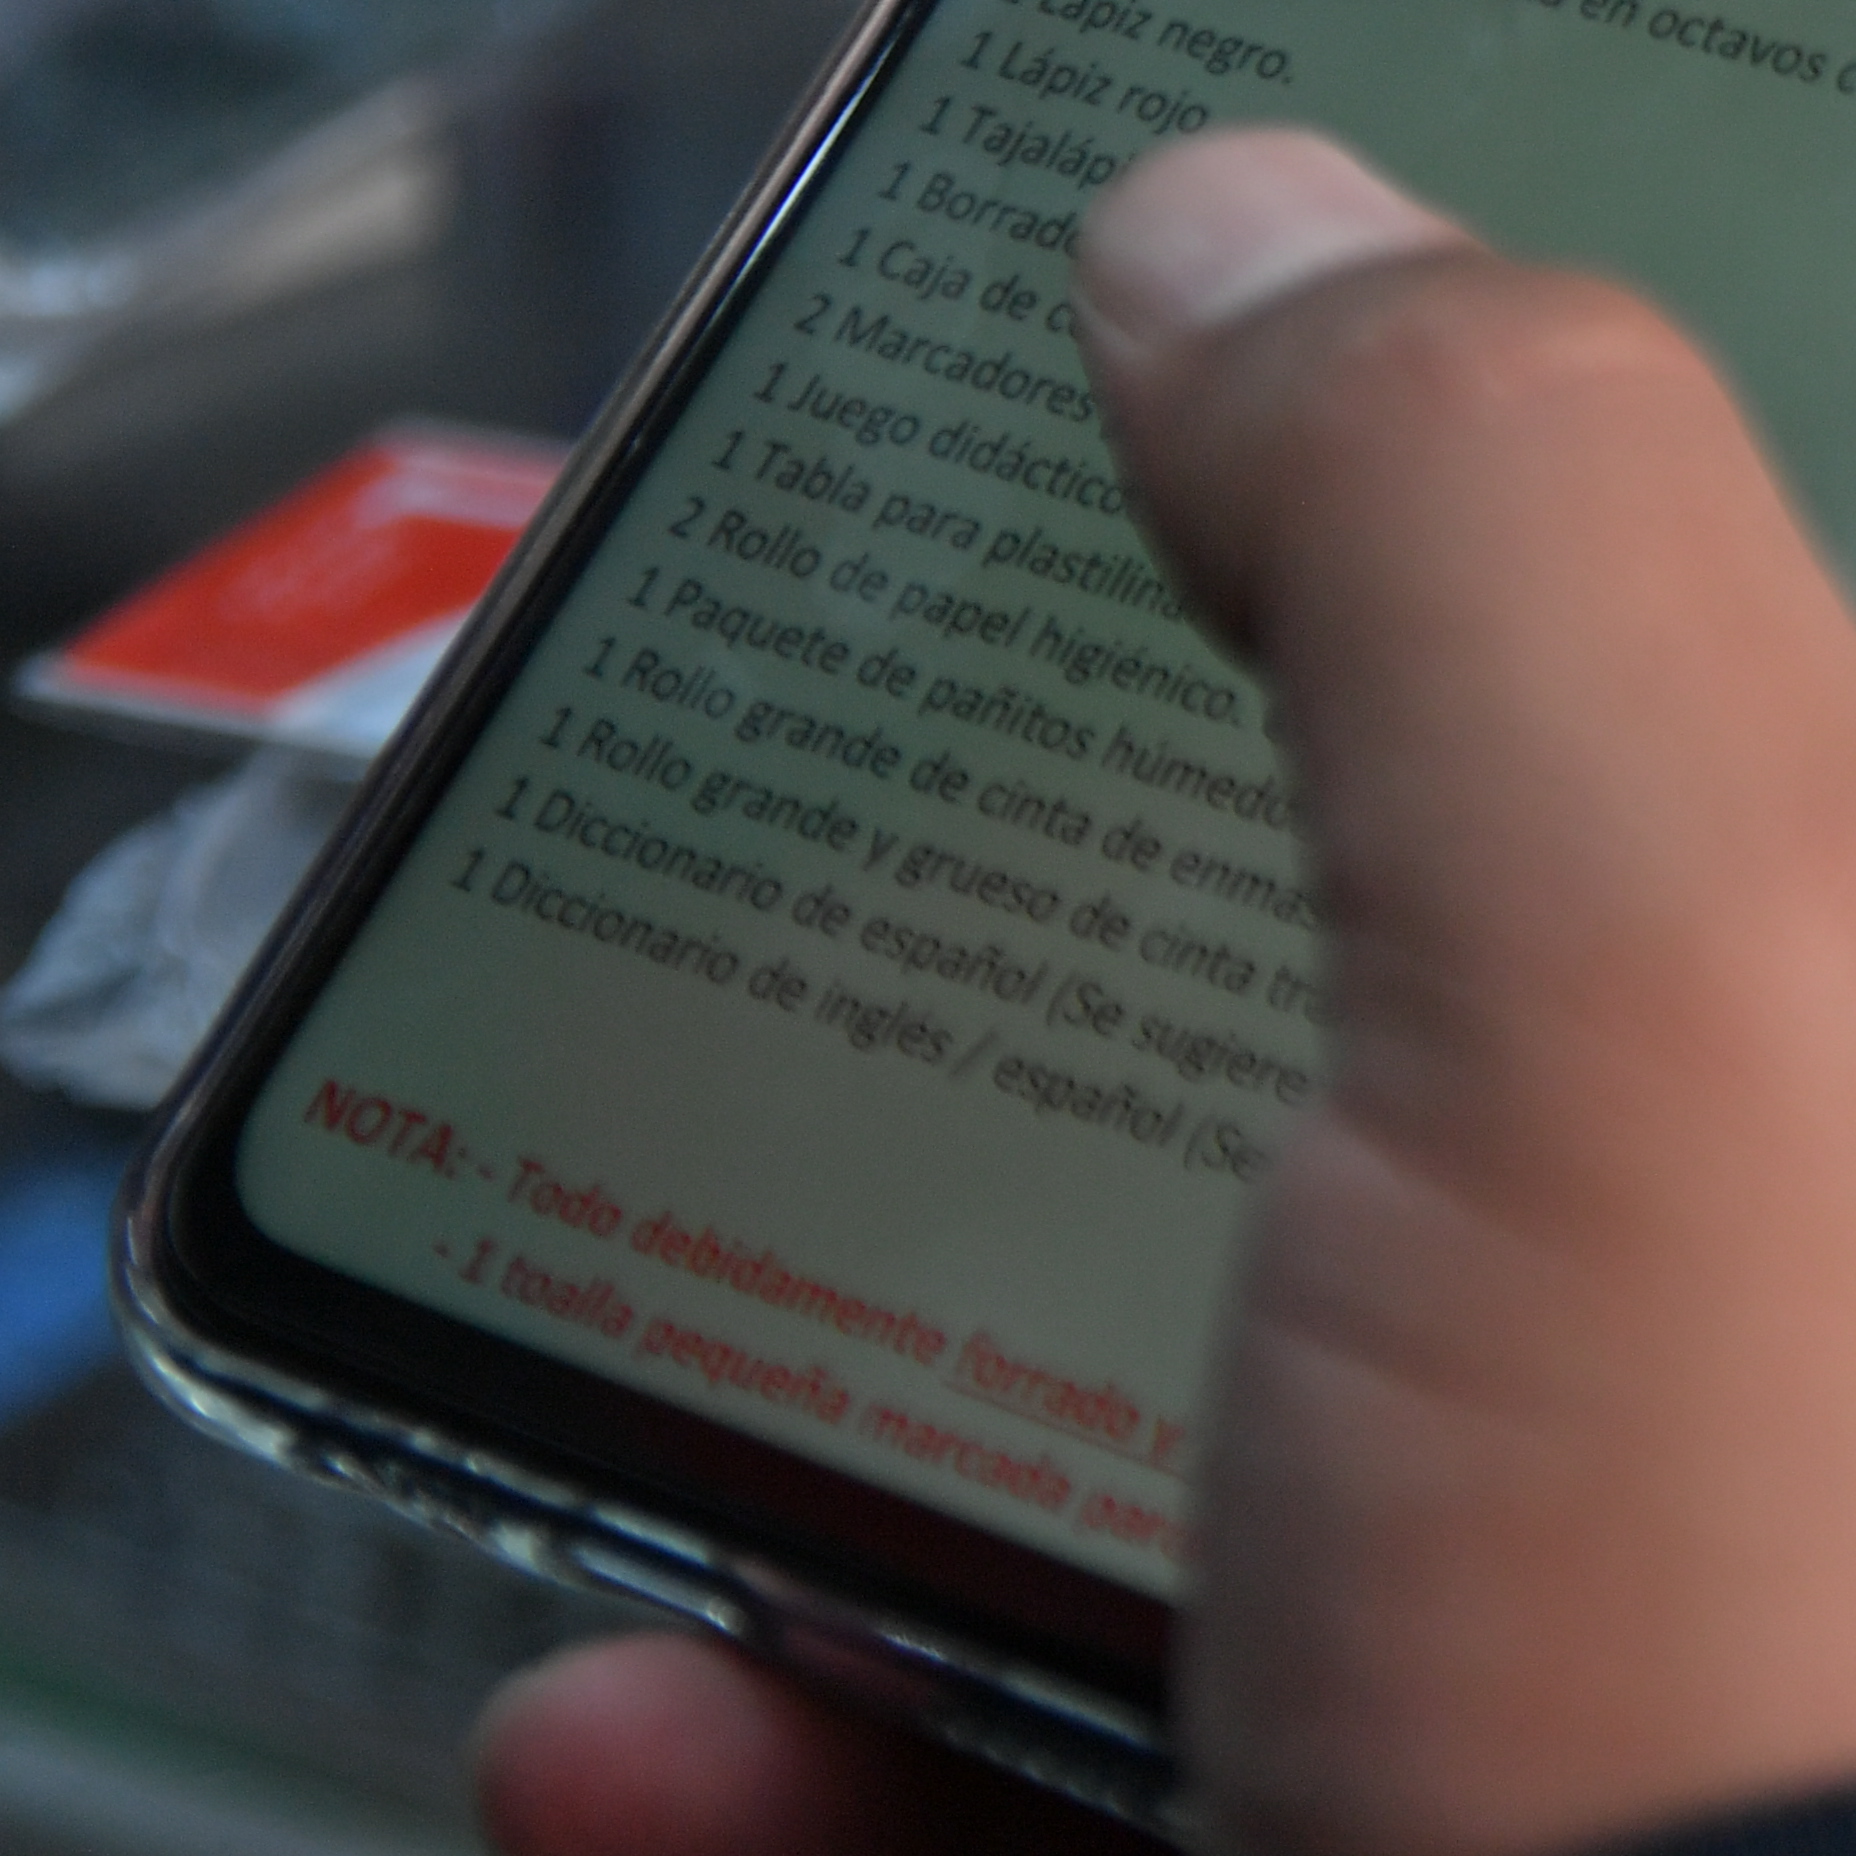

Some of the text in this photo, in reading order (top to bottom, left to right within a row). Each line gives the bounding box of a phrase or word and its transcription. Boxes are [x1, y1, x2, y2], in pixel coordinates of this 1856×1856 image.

[957, 29, 1212, 136] 1 Lápiz rojo
[1156, 18, 1293, 86] negro.
[1647, 6, 1829, 84] octavos
[876, 237, 973, 301] Caja
[978, 272, 1040, 322] de
[785, 373, 922, 447] Juego
[792, 291, 833, 337] 2
[832, 304, 1096, 423] Marcadores
[753, 437, 983, 552] Tabla para
[666, 493, 708, 540] 2
[705, 506, 822, 580] Rollo
[828, 551, 890, 603] de
[888, 580, 1033, 648] papel
[662, 576, 1097, 761] Paquete de pañitos
[619, 646, 1165, 873] Rollo grande de cinta de
[575, 717, 1258, 996] Rollo grande y grueso de cinta
[448, 845, 488, 893] 1
[489, 858, 741, 986] Diccionario
[747, 956, 809, 1012] de
[992, 1054, 1185, 1147] español
[532, 787, 786, 913] Diccionario
[790, 883, 854, 938] de
[859, 915, 1050, 1004] español
[1130, 1013, 1310, 1105] sugiere
